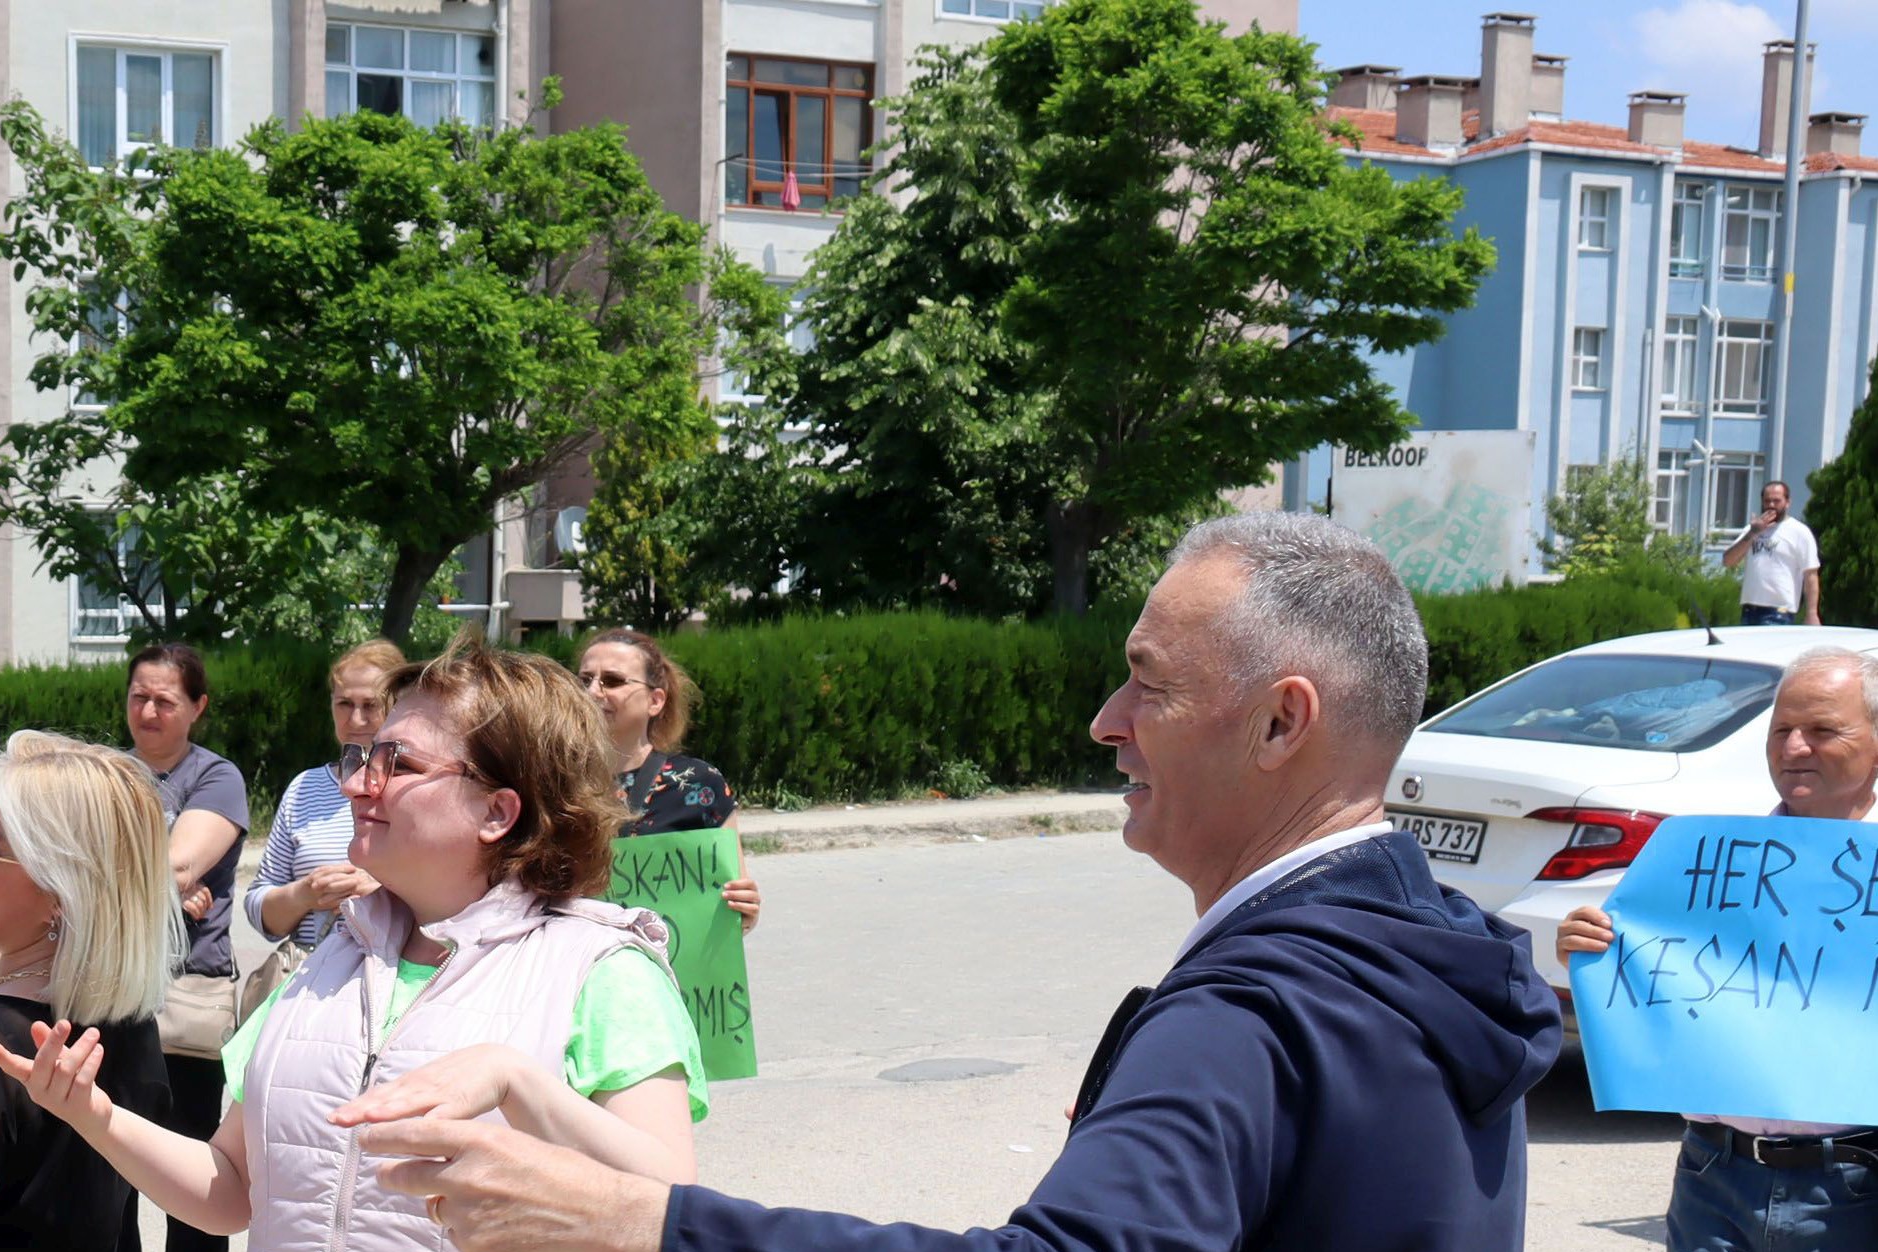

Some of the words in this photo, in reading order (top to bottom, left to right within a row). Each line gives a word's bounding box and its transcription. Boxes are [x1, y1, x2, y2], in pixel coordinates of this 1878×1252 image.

[1438, 822, 1479, 852] 737
[605, 842, 722, 909] ŞKAN!
[1684, 834, 1797, 918] HER
[1606, 931, 1824, 1020] KEŞAN
